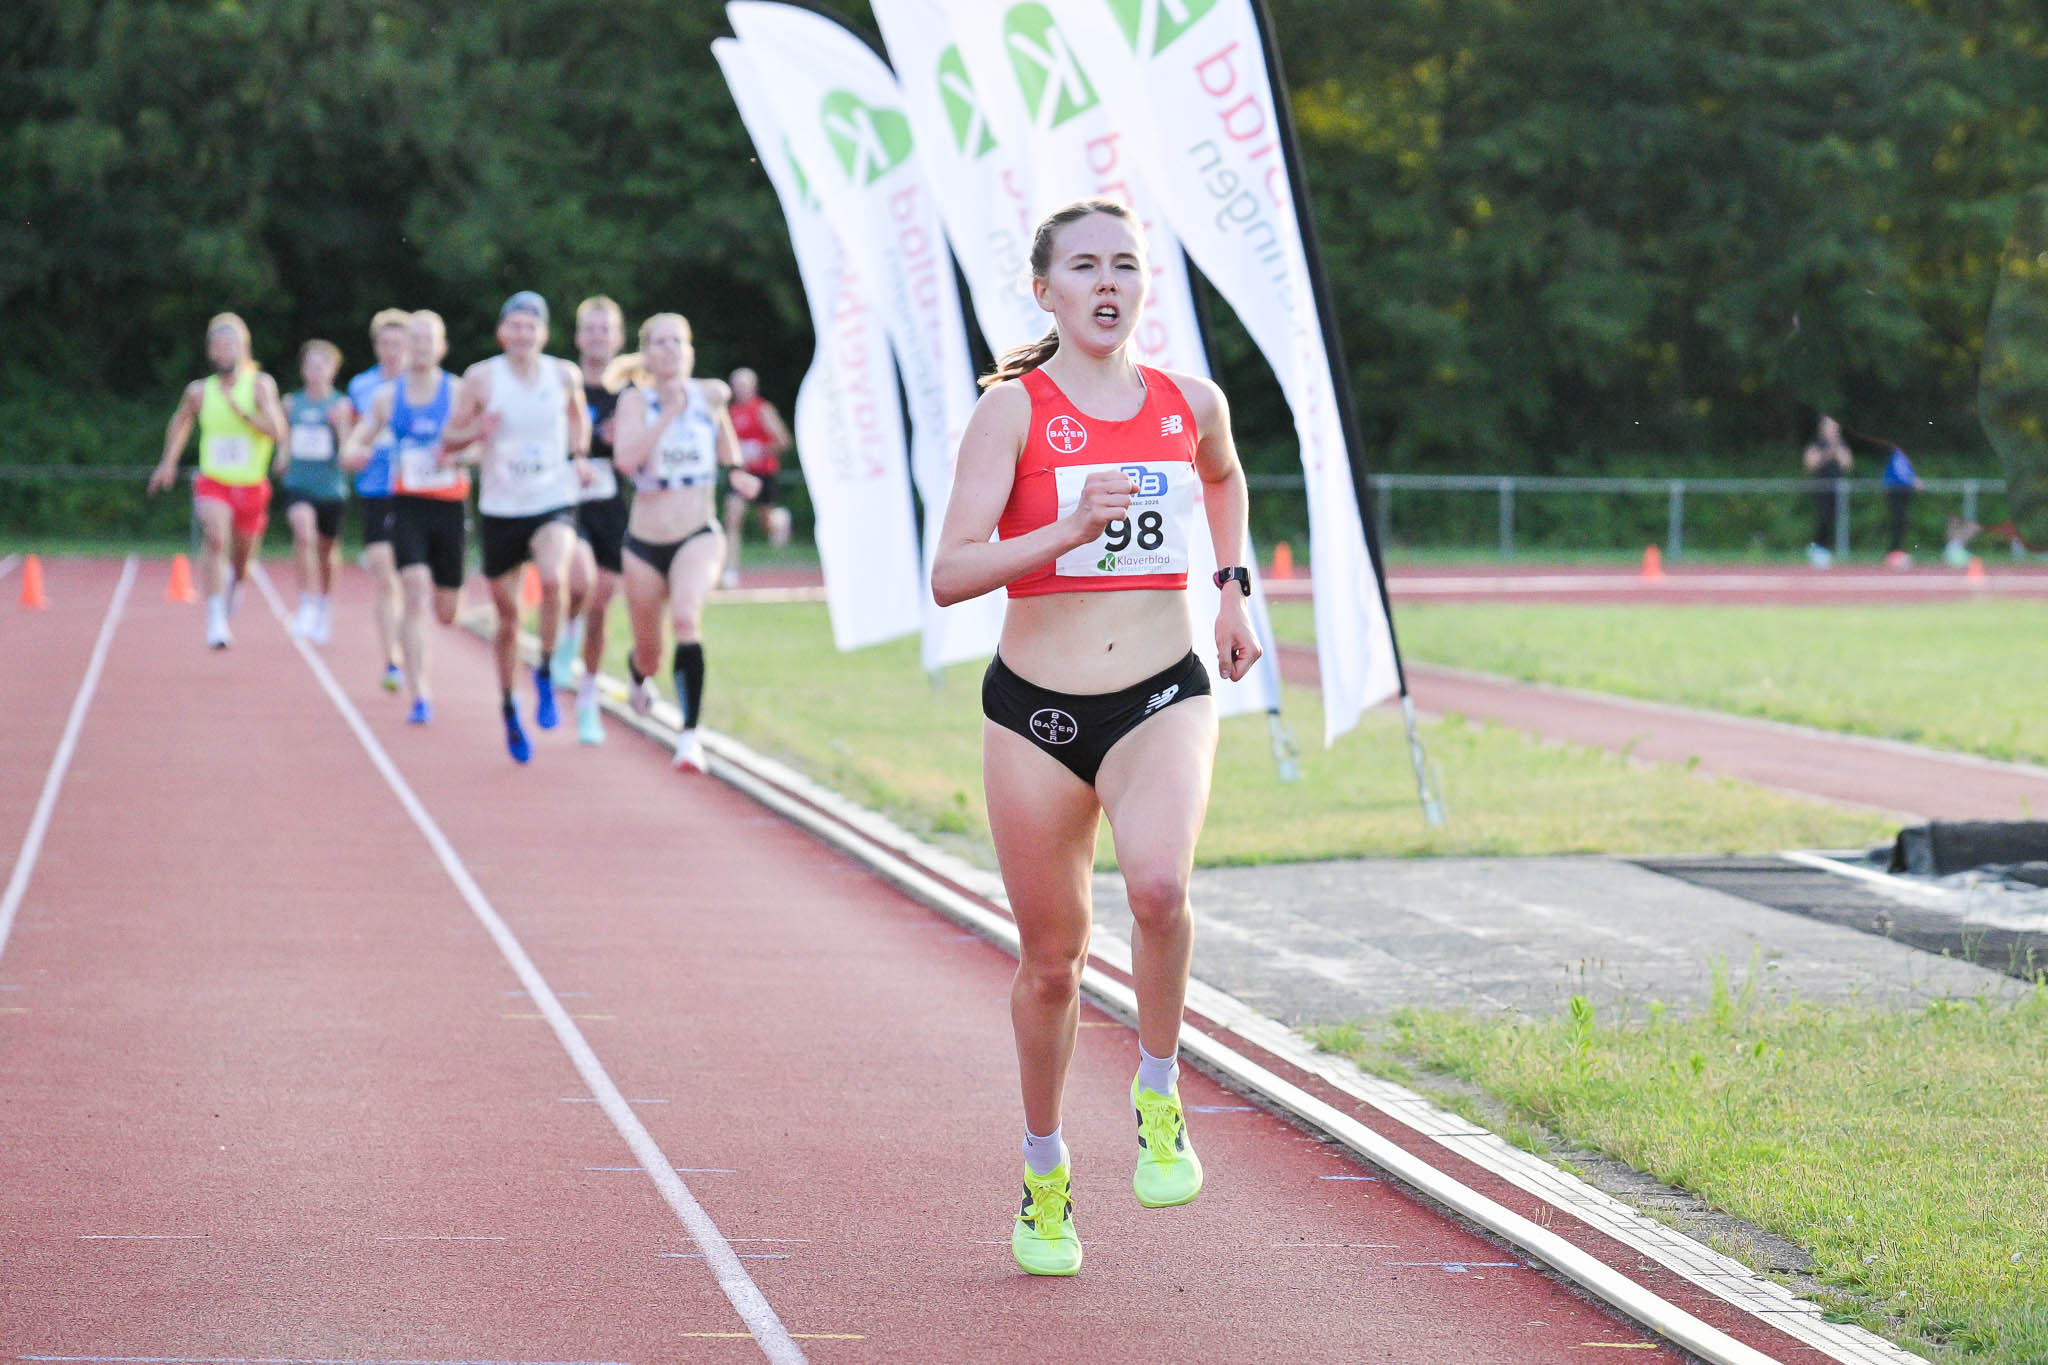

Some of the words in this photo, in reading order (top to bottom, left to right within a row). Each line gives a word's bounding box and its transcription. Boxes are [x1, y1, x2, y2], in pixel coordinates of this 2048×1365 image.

[1050, 429, 1084, 439] BAYER
[1104, 510, 1164, 552] 98
[1117, 553, 1170, 566] Klaverblad
[1033, 719, 1074, 733] BAYER
